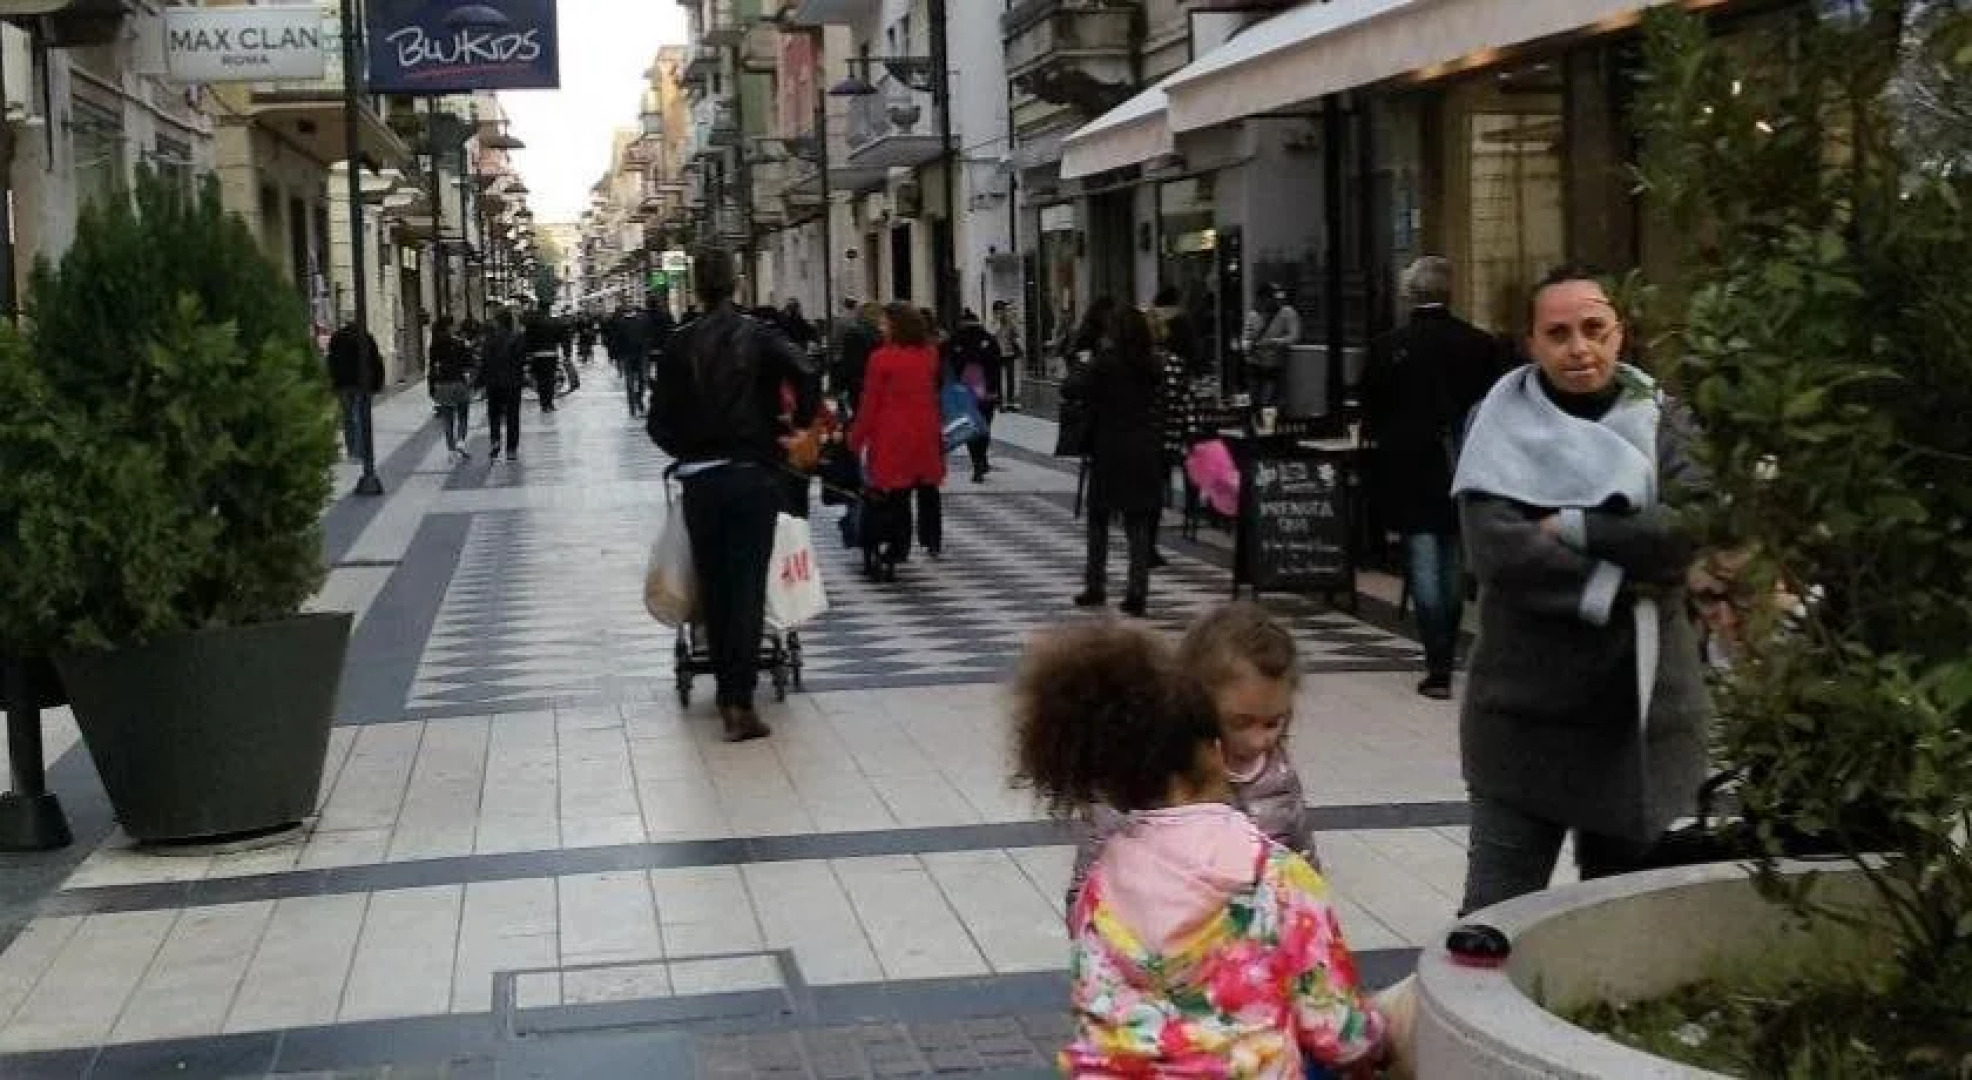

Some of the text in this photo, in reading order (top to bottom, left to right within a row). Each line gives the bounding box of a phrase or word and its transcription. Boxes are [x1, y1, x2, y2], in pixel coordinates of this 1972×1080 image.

[170, 27, 318, 51] MAX CLAN
[221, 54, 270, 65] ROMA
